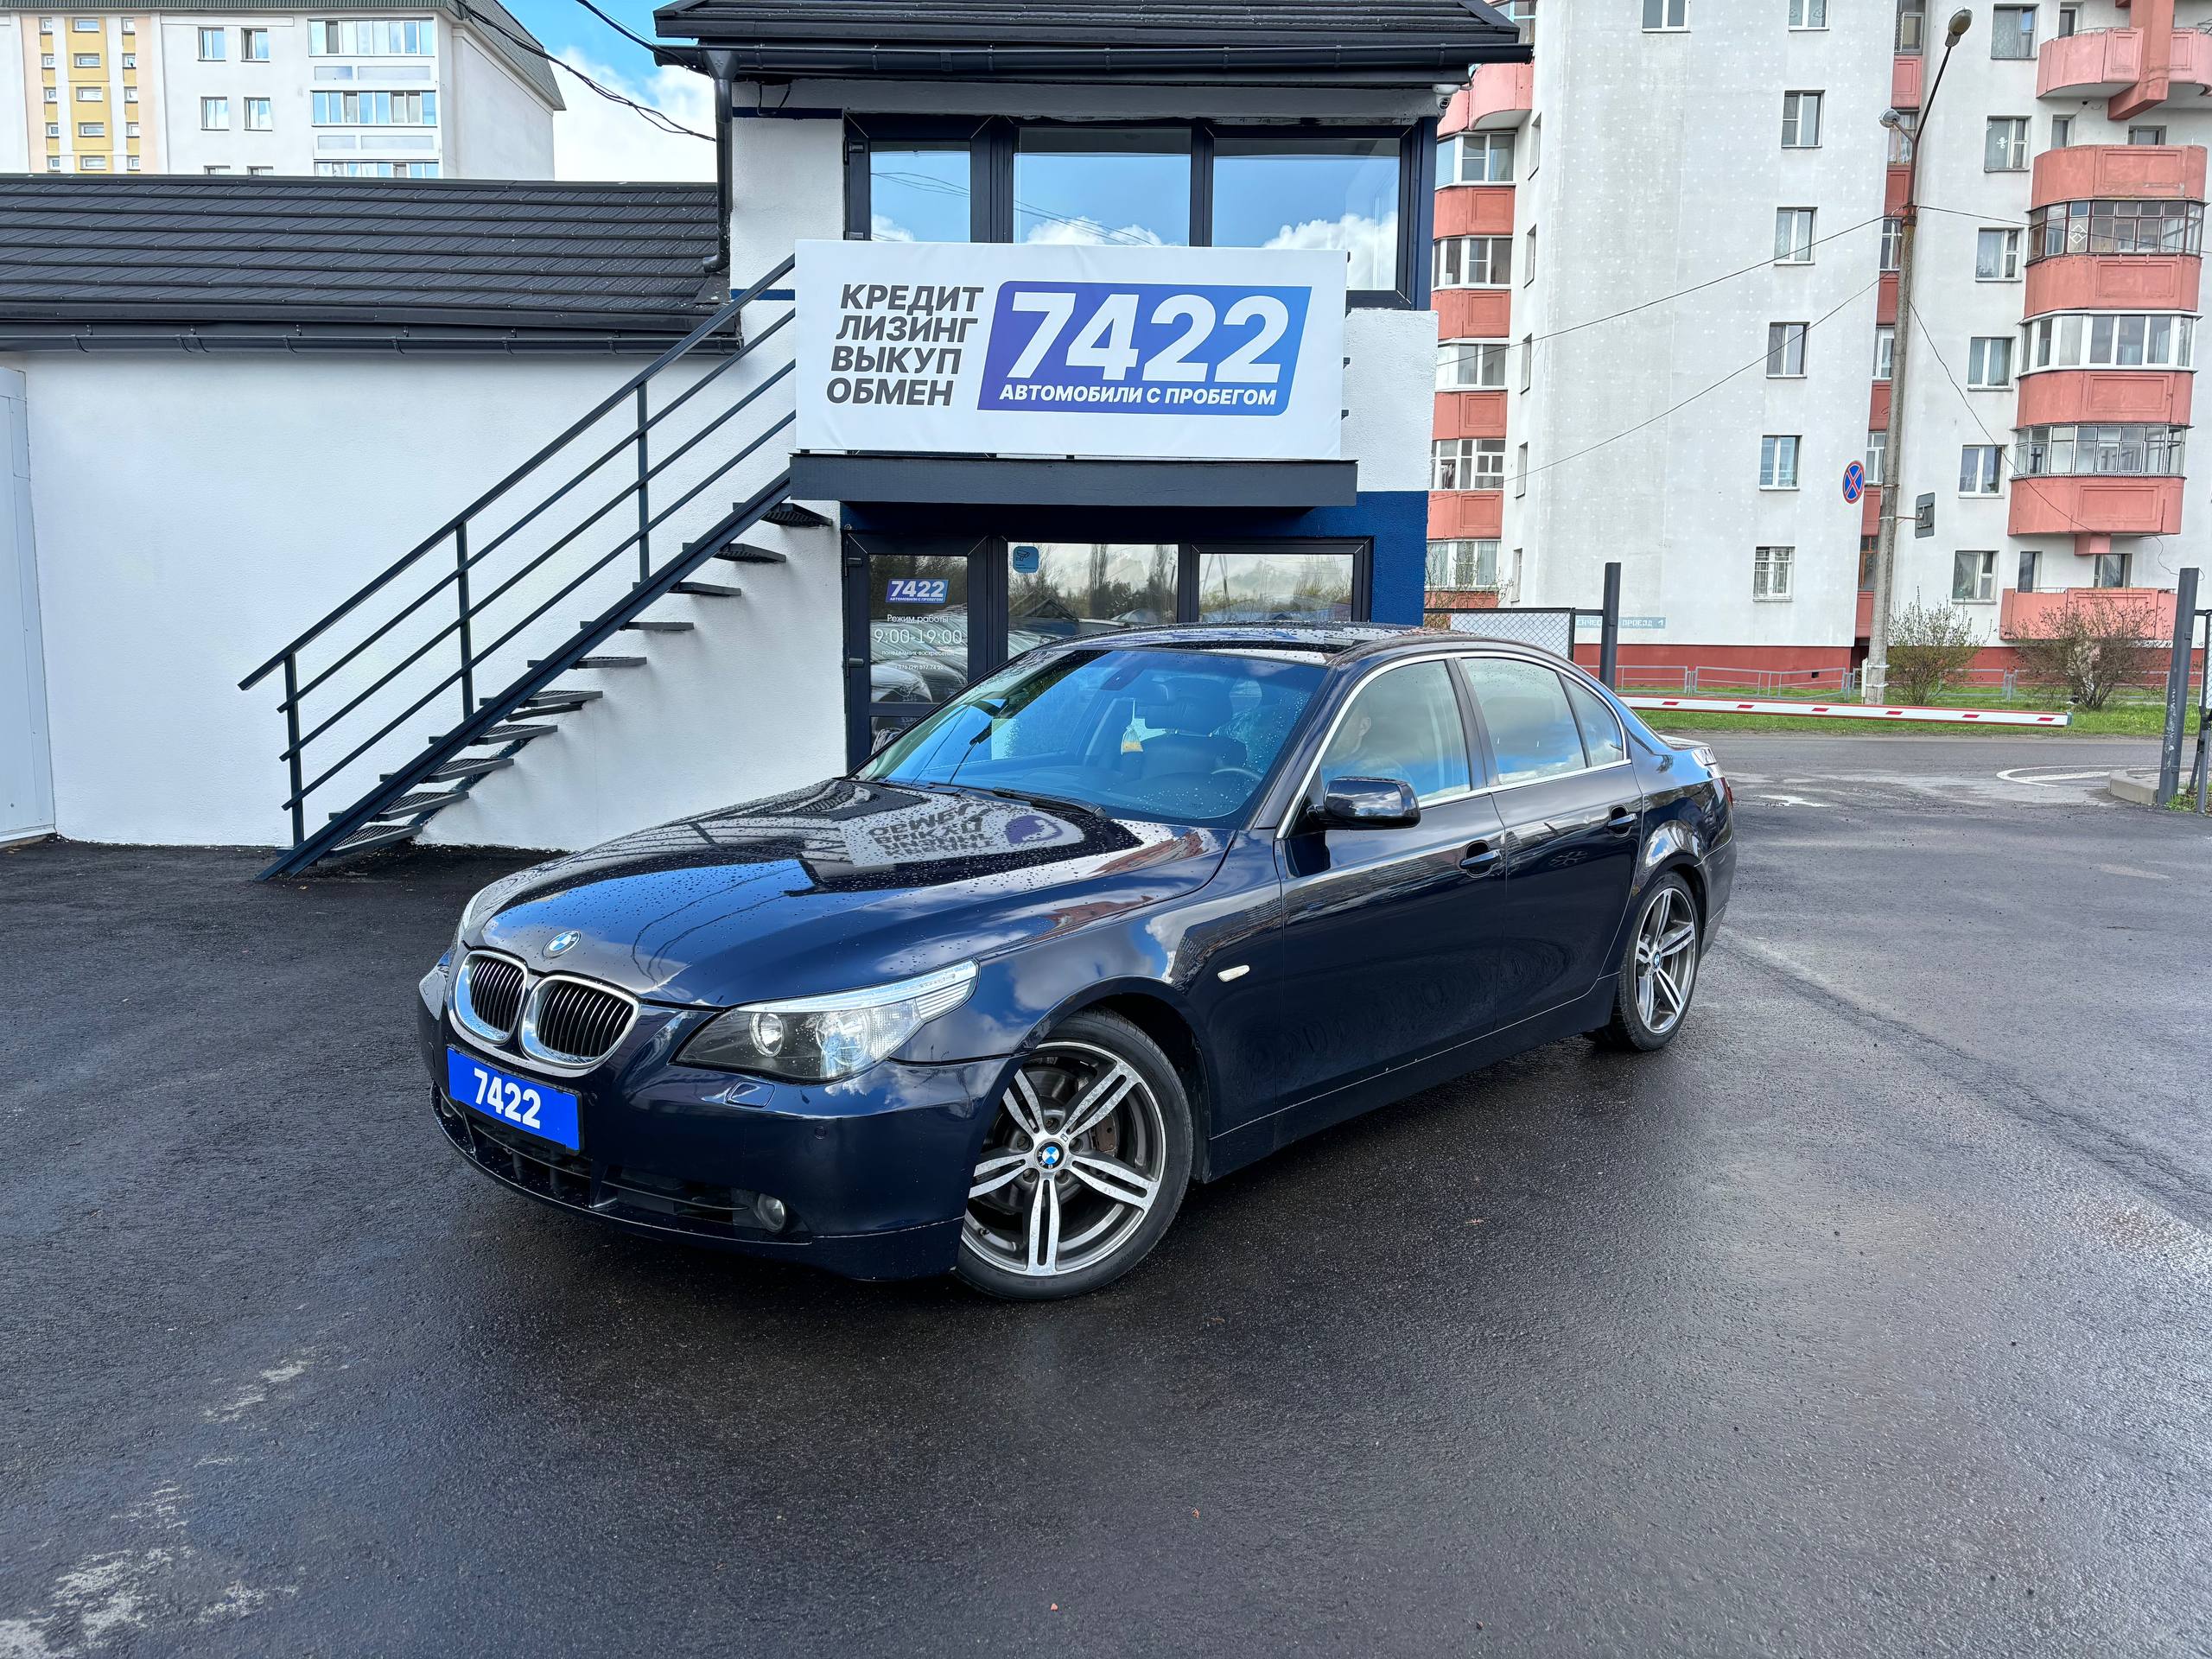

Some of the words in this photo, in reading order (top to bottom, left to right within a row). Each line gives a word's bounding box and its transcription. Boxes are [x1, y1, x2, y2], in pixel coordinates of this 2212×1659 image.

[840, 283, 984, 316] КРЕДИТ
[836, 315, 978, 342] ЛИЗИНГ
[1006, 291, 1289, 384] 7422
[831, 346, 962, 374] ВЫКУП
[826, 377, 954, 406] ОБМЕН
[999, 385, 1142, 404] АВТОМОБИЛИ
[1147, 388, 1160, 404] С
[1165, 388, 1277, 405] ПРОБЕГОМ
[891, 581, 944, 597] 7422
[917, 614, 949, 625] работы
[874, 629, 963, 644] 9:00-19:00
[474, 1067, 541, 1129] 7422
